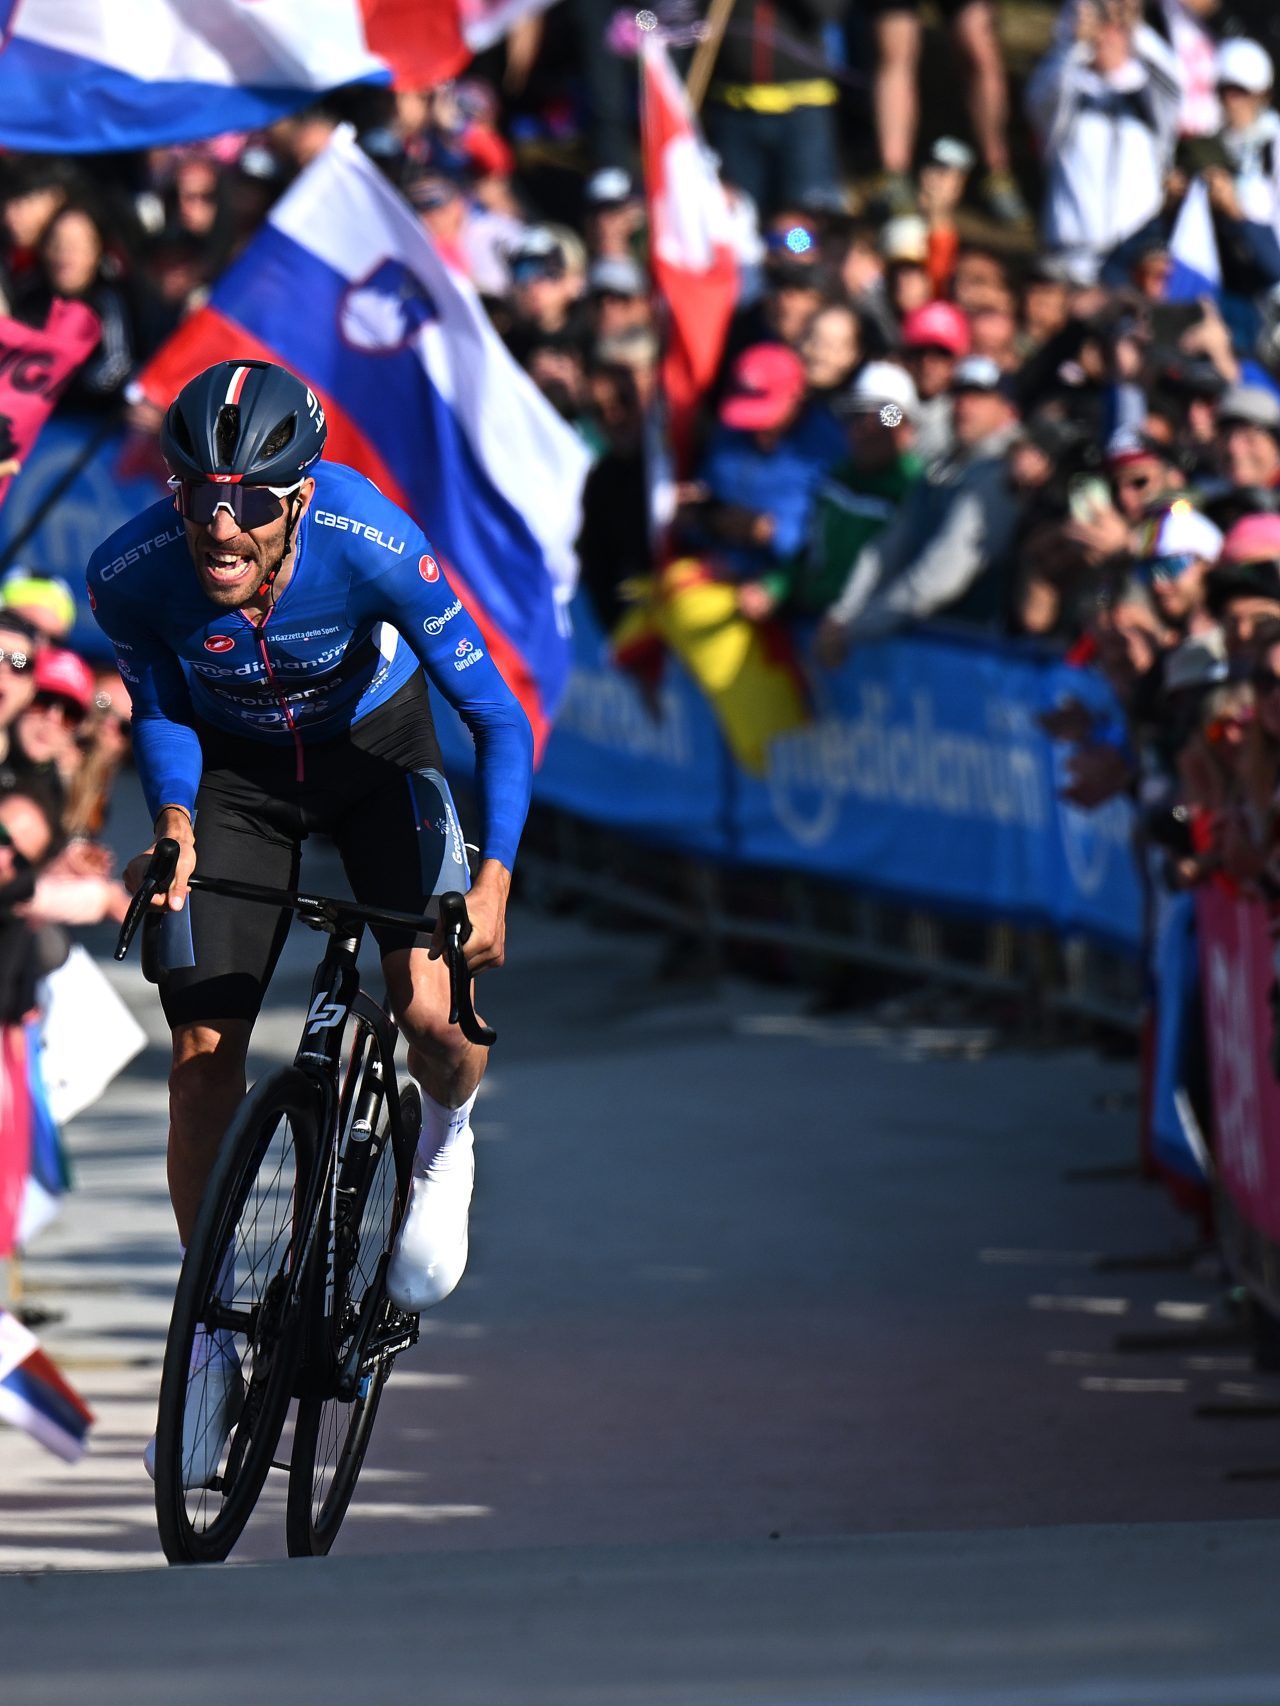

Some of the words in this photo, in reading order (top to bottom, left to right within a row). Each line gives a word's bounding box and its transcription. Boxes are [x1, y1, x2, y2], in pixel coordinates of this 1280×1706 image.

[99, 526, 186, 582] CASTELL
[276, 632, 305, 642] Gazzetta
[305, 629, 321, 637] dello
[321, 625, 340, 637] Sport
